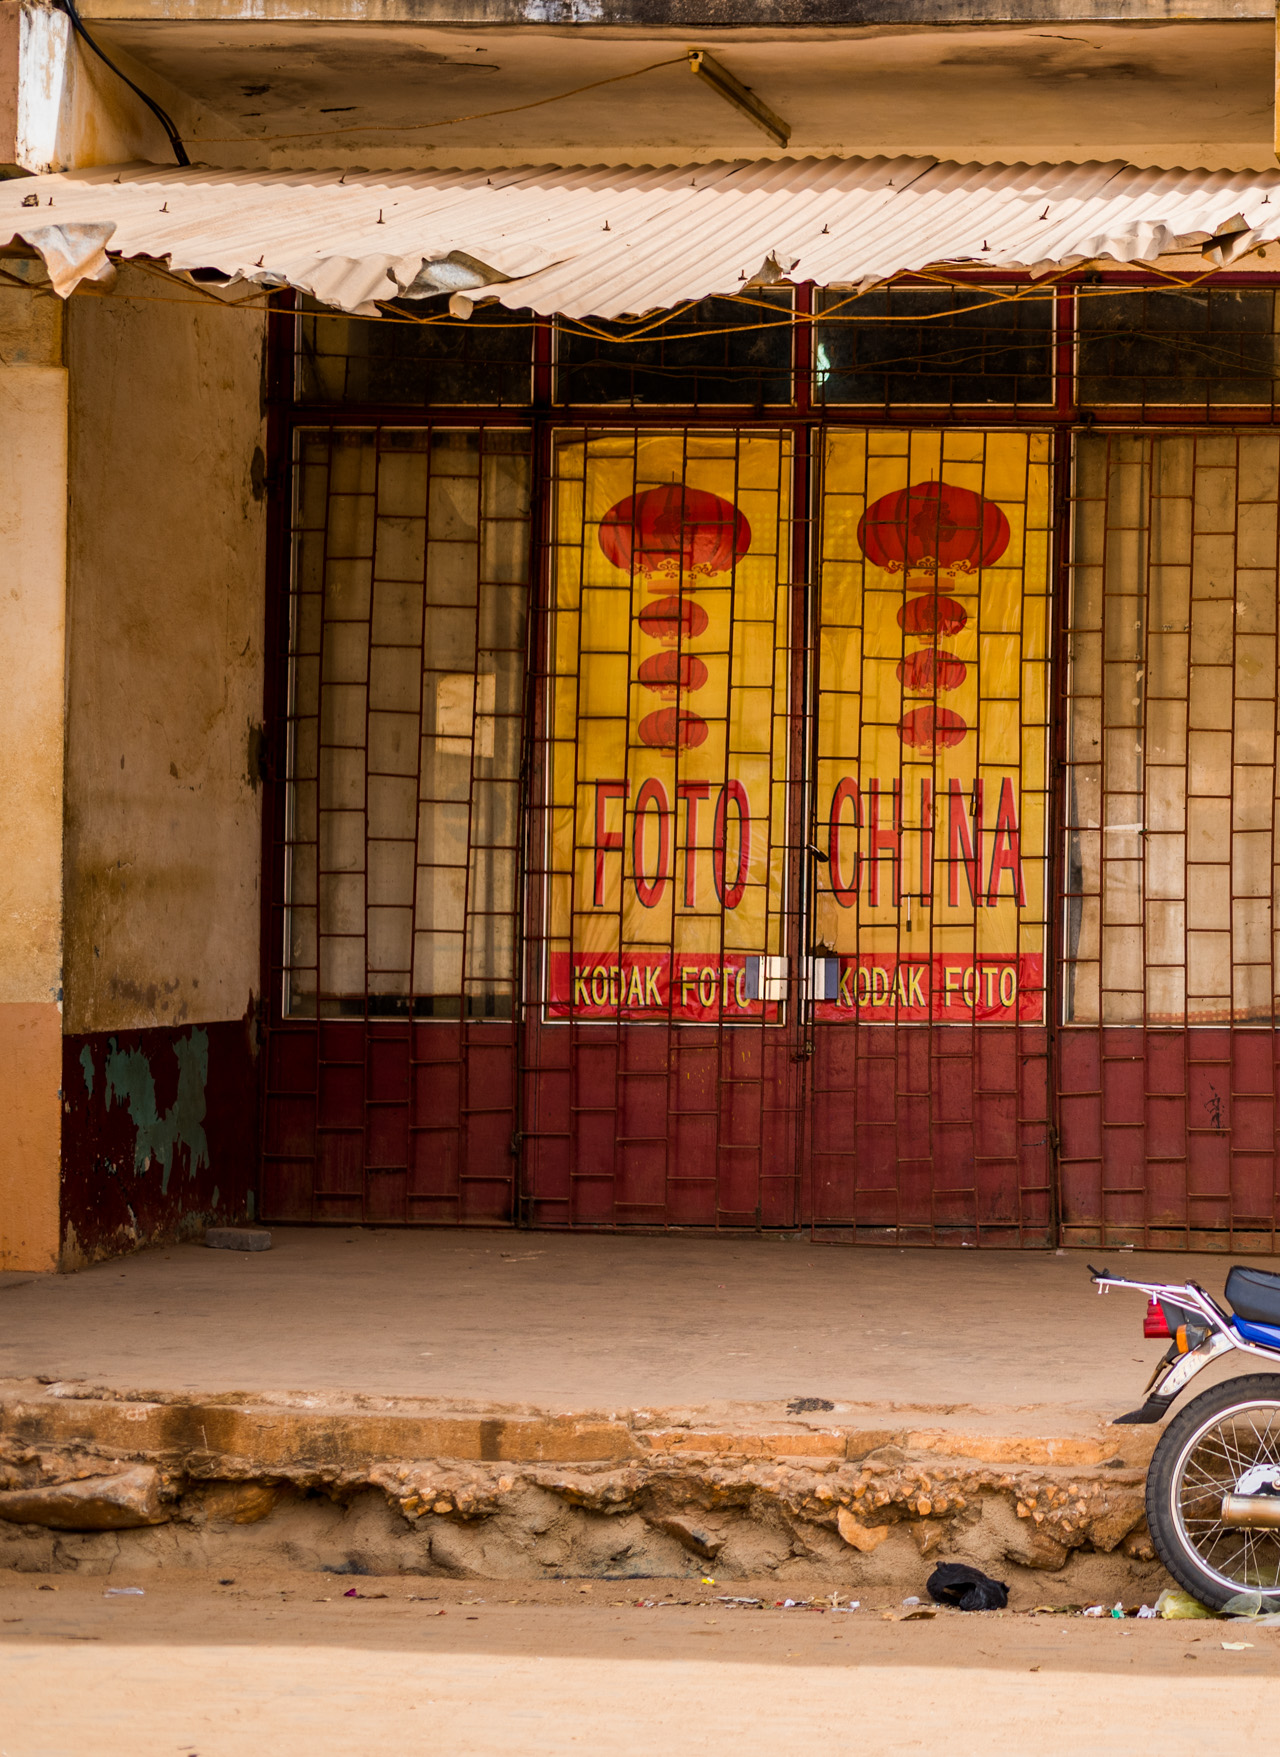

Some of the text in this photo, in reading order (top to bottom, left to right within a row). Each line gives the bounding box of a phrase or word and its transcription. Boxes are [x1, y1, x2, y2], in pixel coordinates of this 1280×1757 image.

[593, 776, 1026, 910] FOTO CHINA
[574, 965, 662, 1006] KODAK
[835, 966, 1016, 1008] KODAK FOTO
